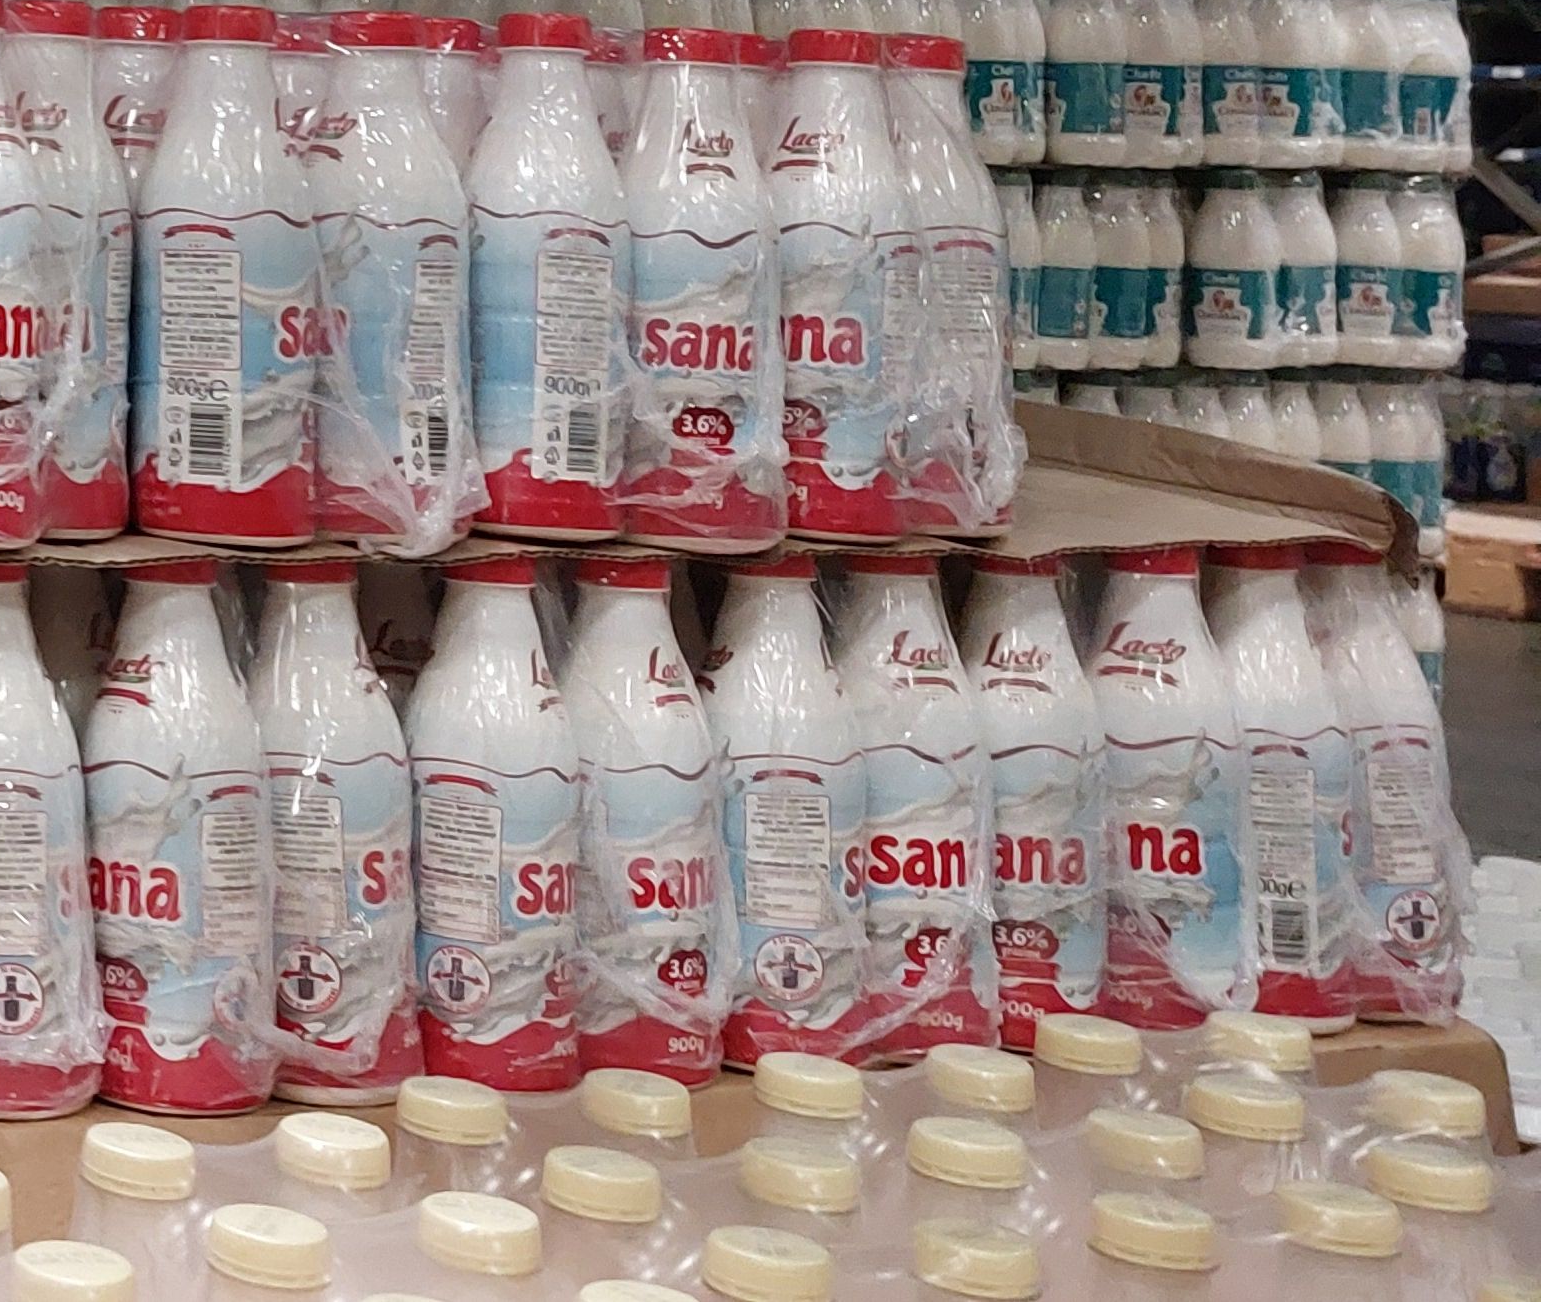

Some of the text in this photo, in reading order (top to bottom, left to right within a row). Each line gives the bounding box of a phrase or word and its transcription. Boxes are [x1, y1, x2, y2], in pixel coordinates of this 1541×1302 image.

[781, 313, 863, 365] na
[680, 413, 728, 436] 3.6%
[1102, 620, 1188, 664] Lacto
[867, 834, 967, 889] san
[995, 833, 1087, 885] ana
[1127, 822, 1203, 876] na
[88, 855, 182, 922] ana
[517, 861, 576, 917] sa
[627, 856, 715, 911] san
[917, 933, 949, 956] 3.6
[995, 924, 1049, 949] 3.6%
[103, 965, 135, 990] .6%
[668, 956, 706, 981] 3.6%
